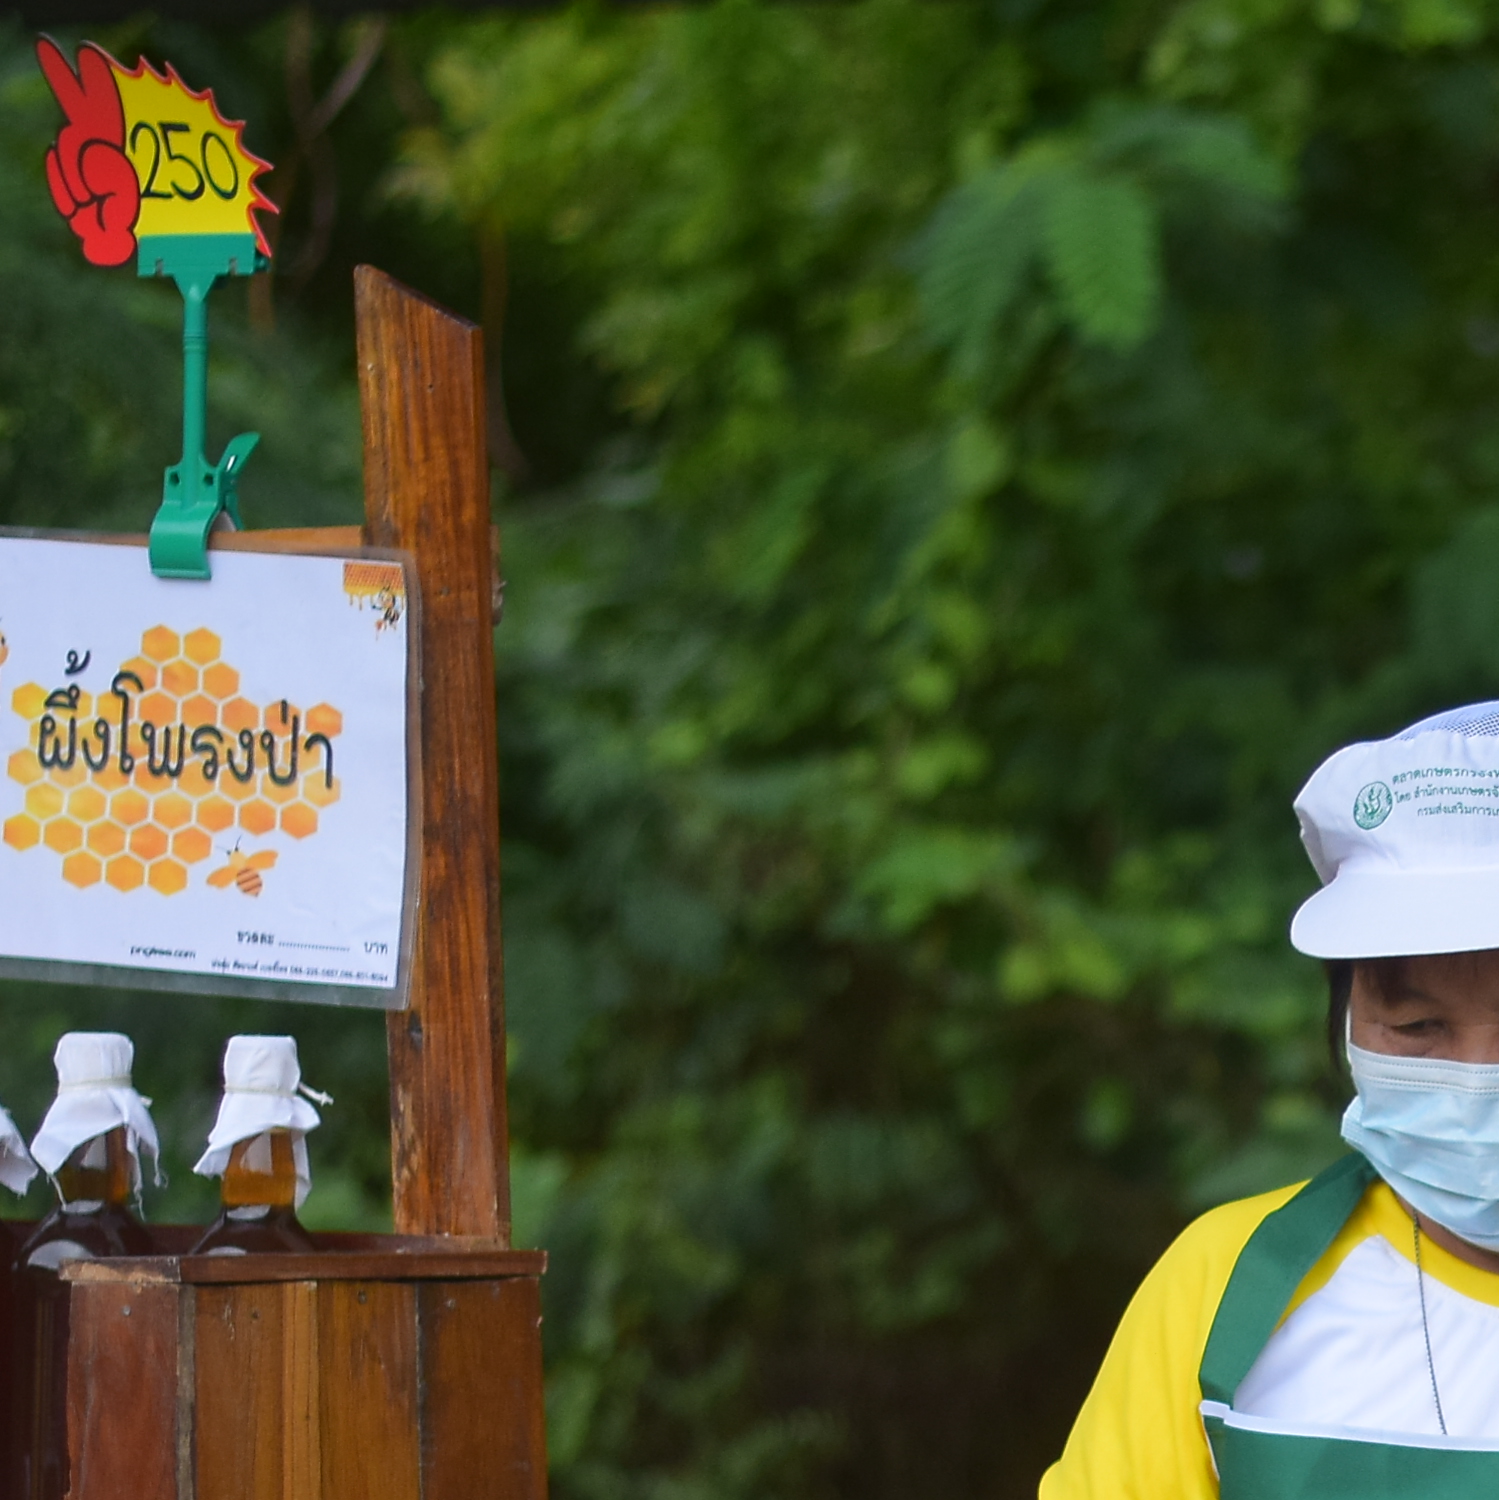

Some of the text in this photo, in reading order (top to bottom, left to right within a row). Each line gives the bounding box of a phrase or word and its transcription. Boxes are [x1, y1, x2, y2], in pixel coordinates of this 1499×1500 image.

[128, 120, 239, 201] 250
[37, 648, 335, 790] ผึ้งโพรงป่า
